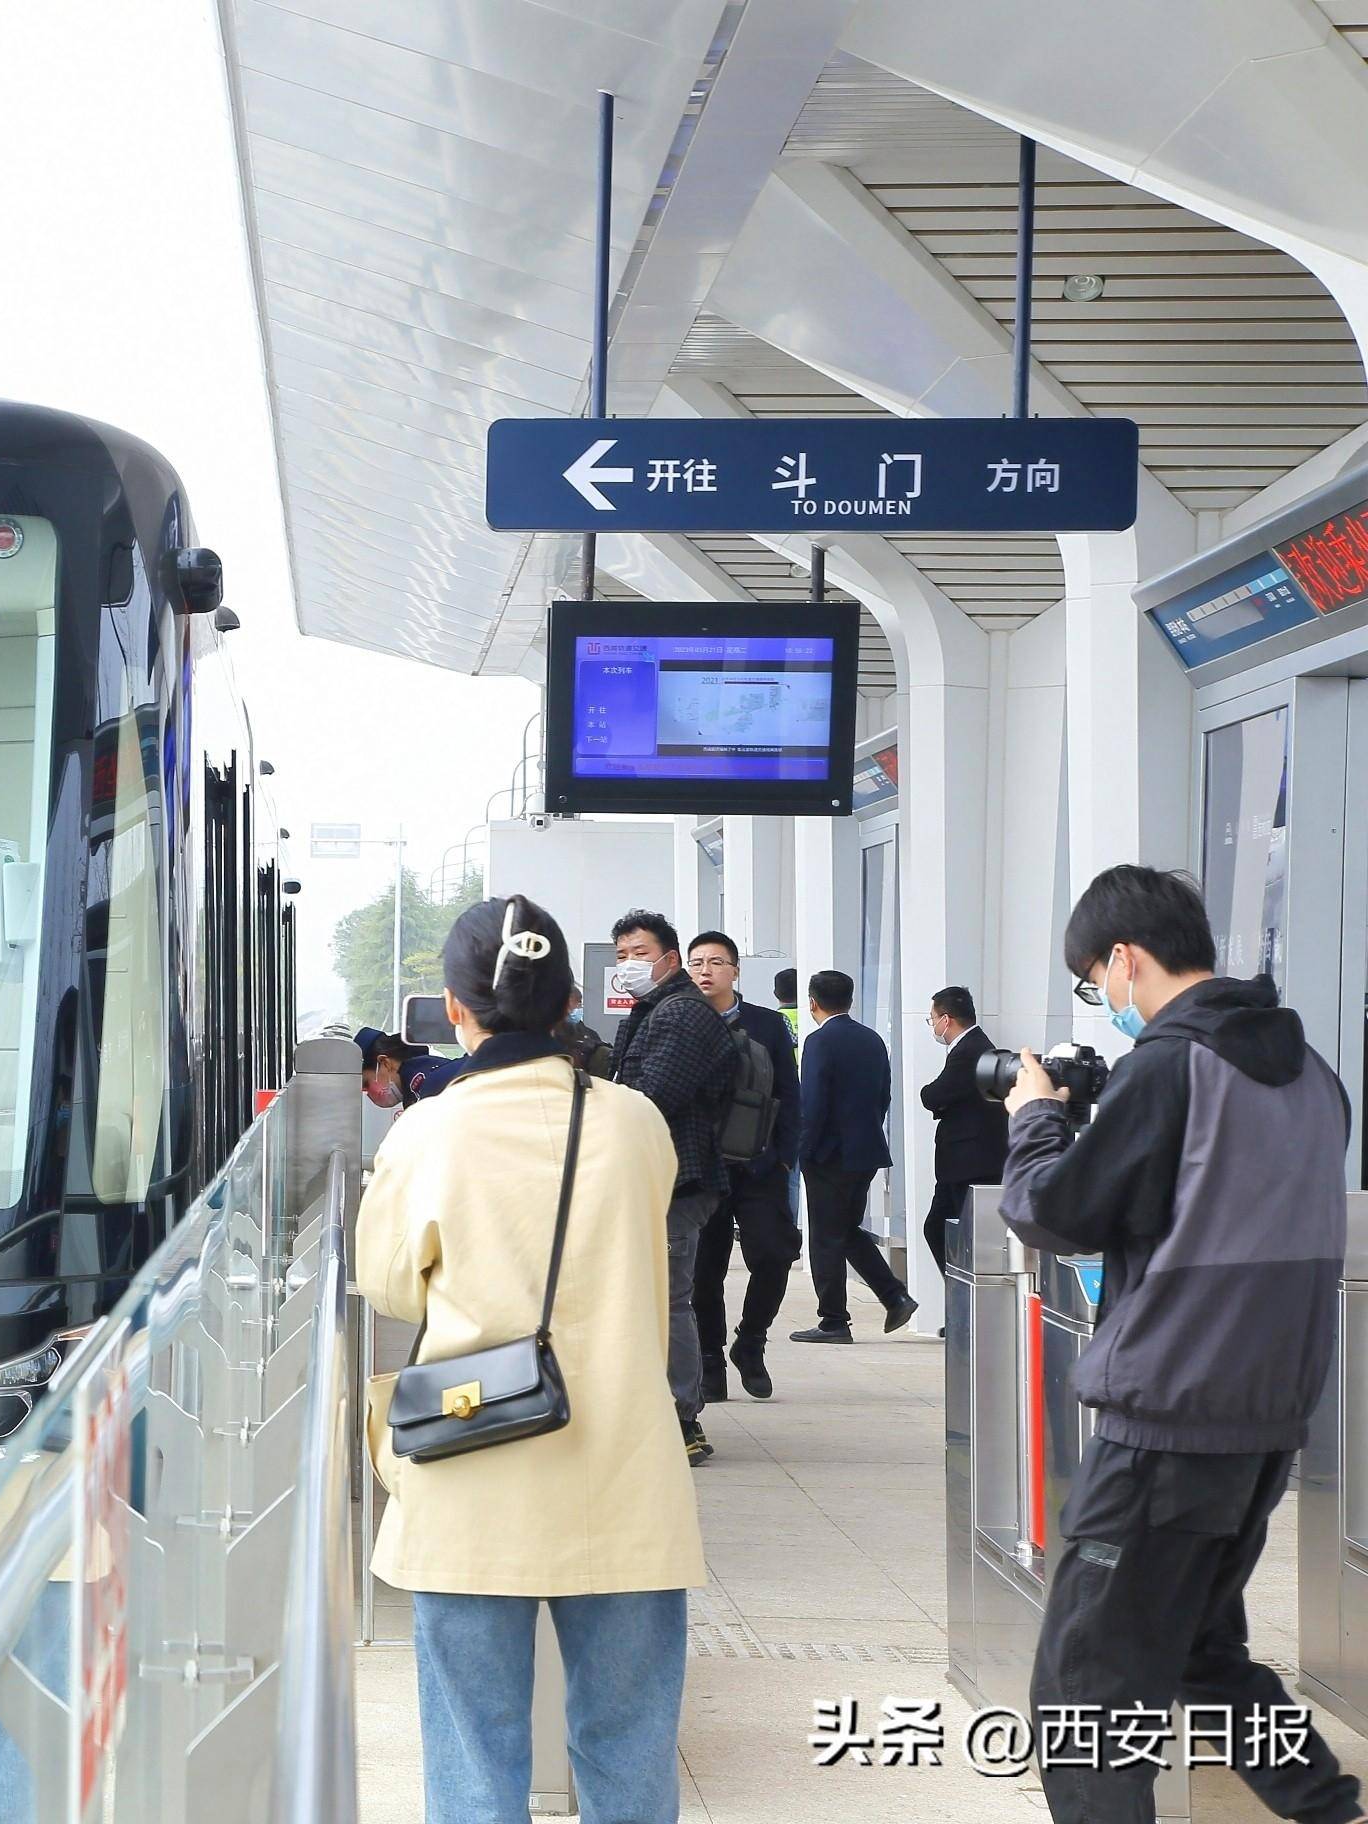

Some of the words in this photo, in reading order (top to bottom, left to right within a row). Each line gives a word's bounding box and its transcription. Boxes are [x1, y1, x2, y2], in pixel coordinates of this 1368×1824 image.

[646, 459, 718, 492] 开往
[986, 457, 1060, 492] 方向
[791, 500, 818, 515] TO
[823, 500, 911, 515] DOUMEN
